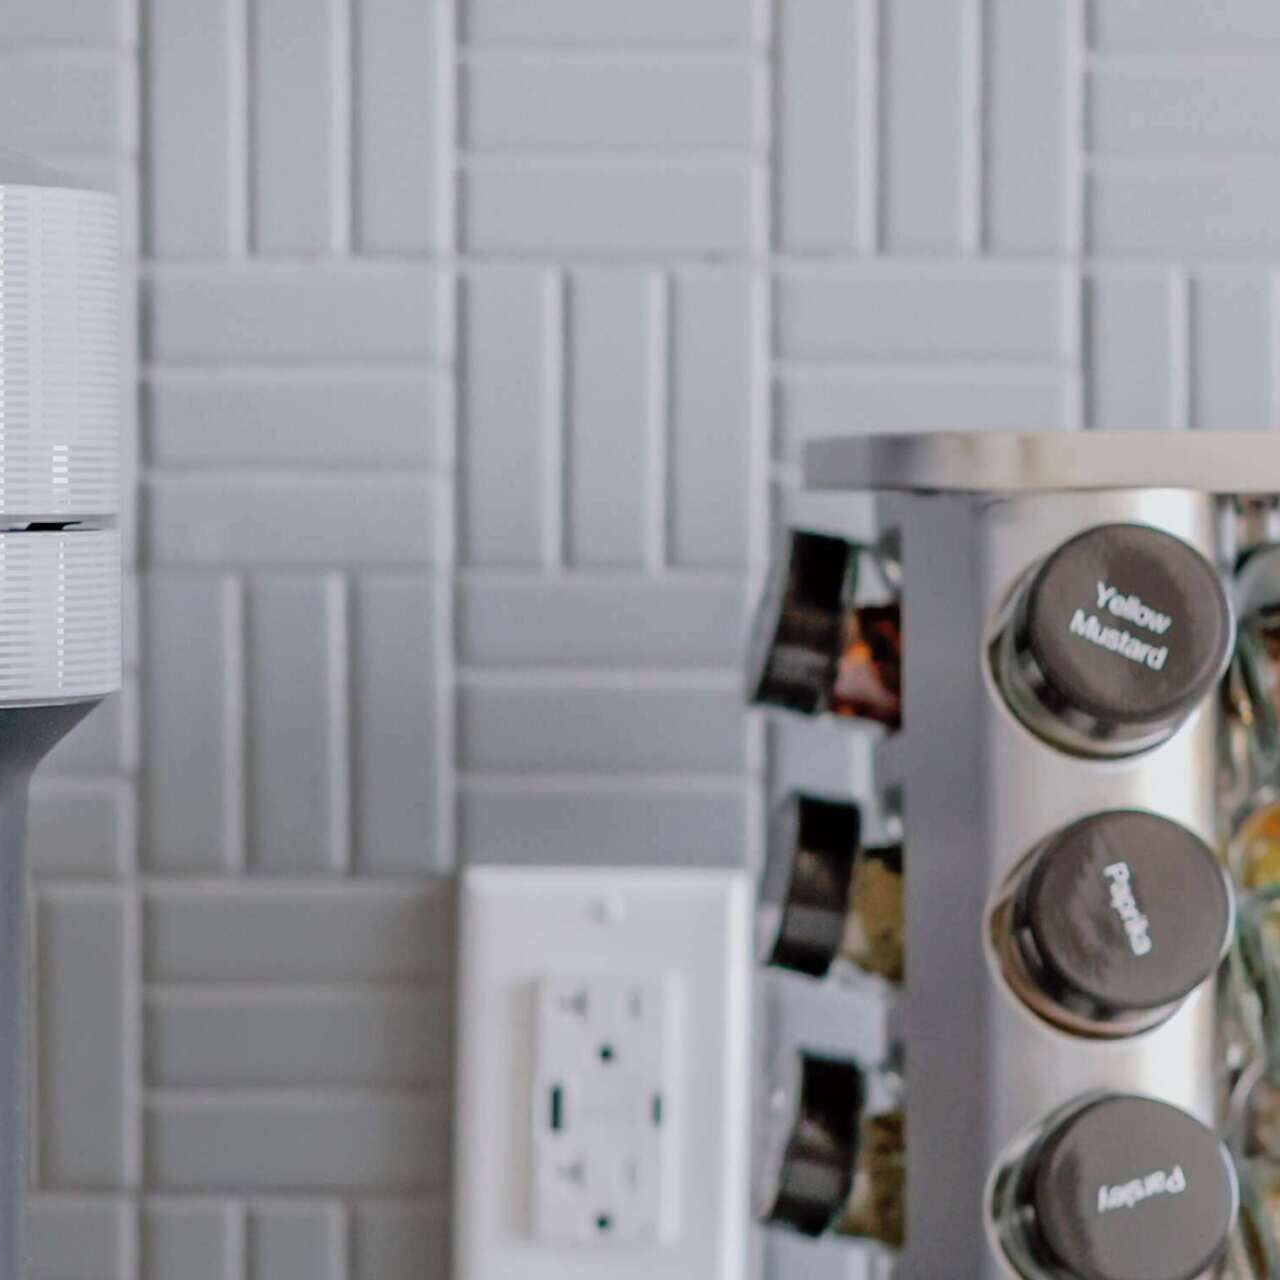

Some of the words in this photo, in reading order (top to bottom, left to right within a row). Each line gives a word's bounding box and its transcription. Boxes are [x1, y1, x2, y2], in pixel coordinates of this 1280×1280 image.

[1096, 580, 1172, 634] Yellow
[1070, 608, 1168, 670] Mustard
[1098, 1164, 1187, 1213] Parsley
